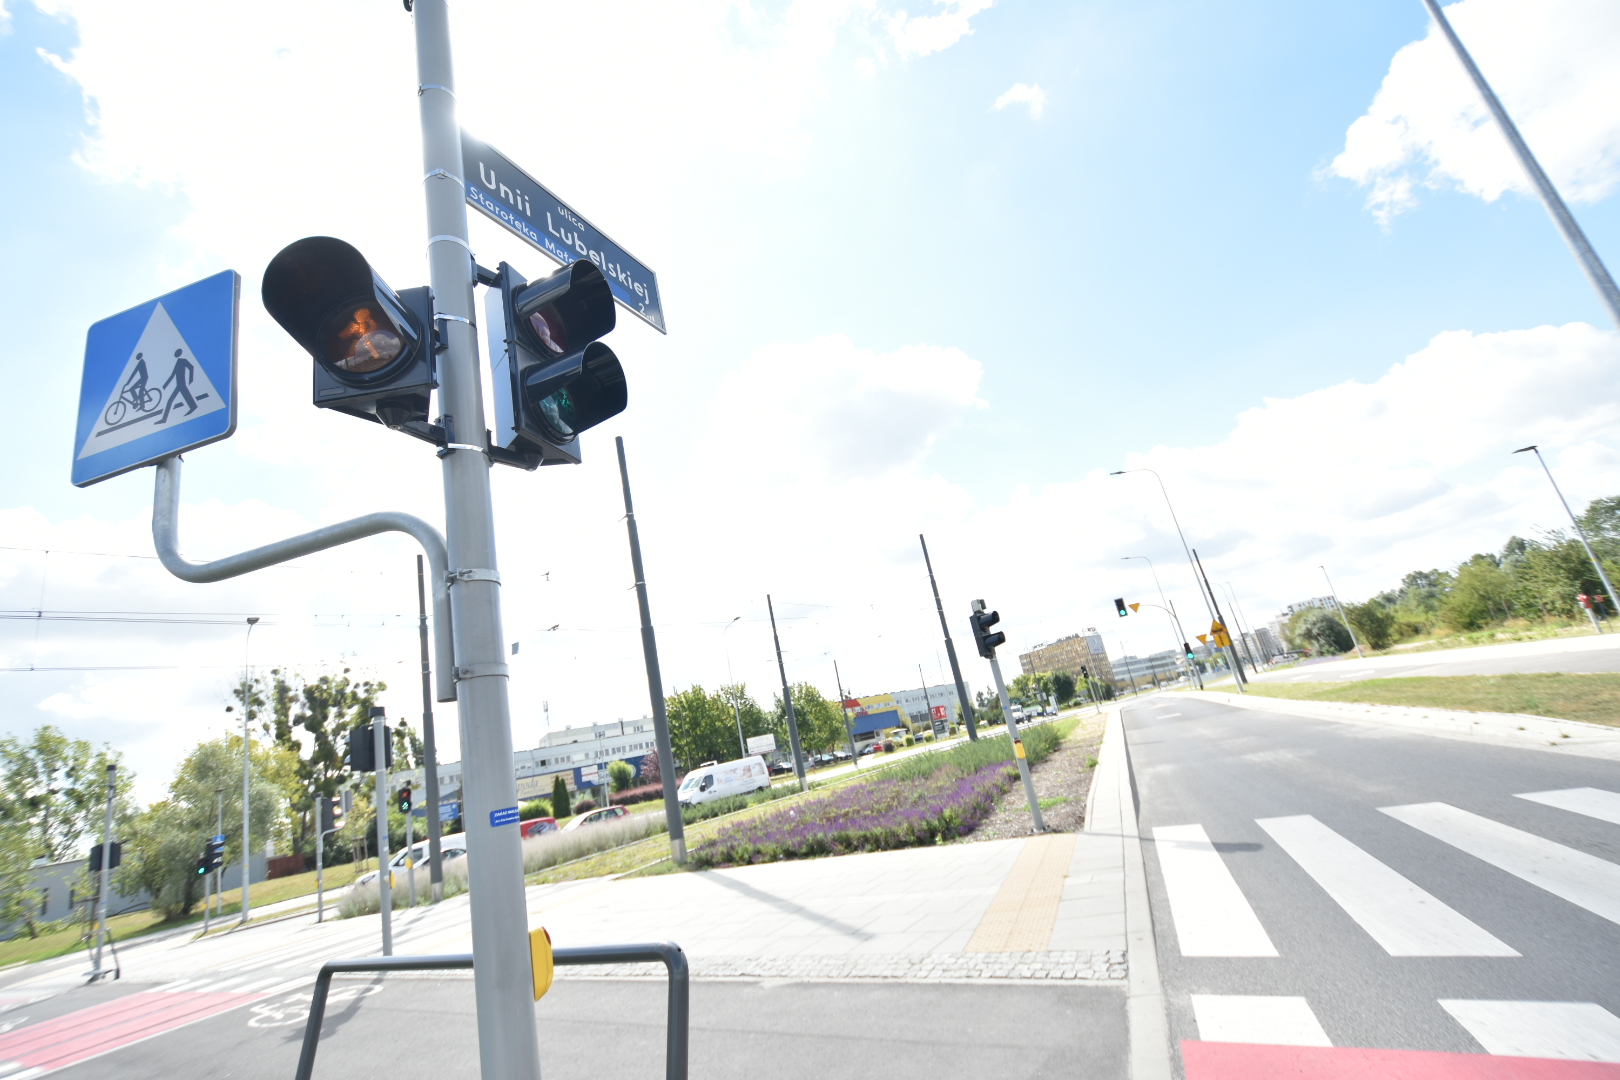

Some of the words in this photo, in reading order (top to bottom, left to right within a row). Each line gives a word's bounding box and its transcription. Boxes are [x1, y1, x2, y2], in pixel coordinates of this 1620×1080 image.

[479, 161, 531, 217] Unii
[546, 211, 650, 305] Lubelskiej
[557, 206, 585, 232] ulica
